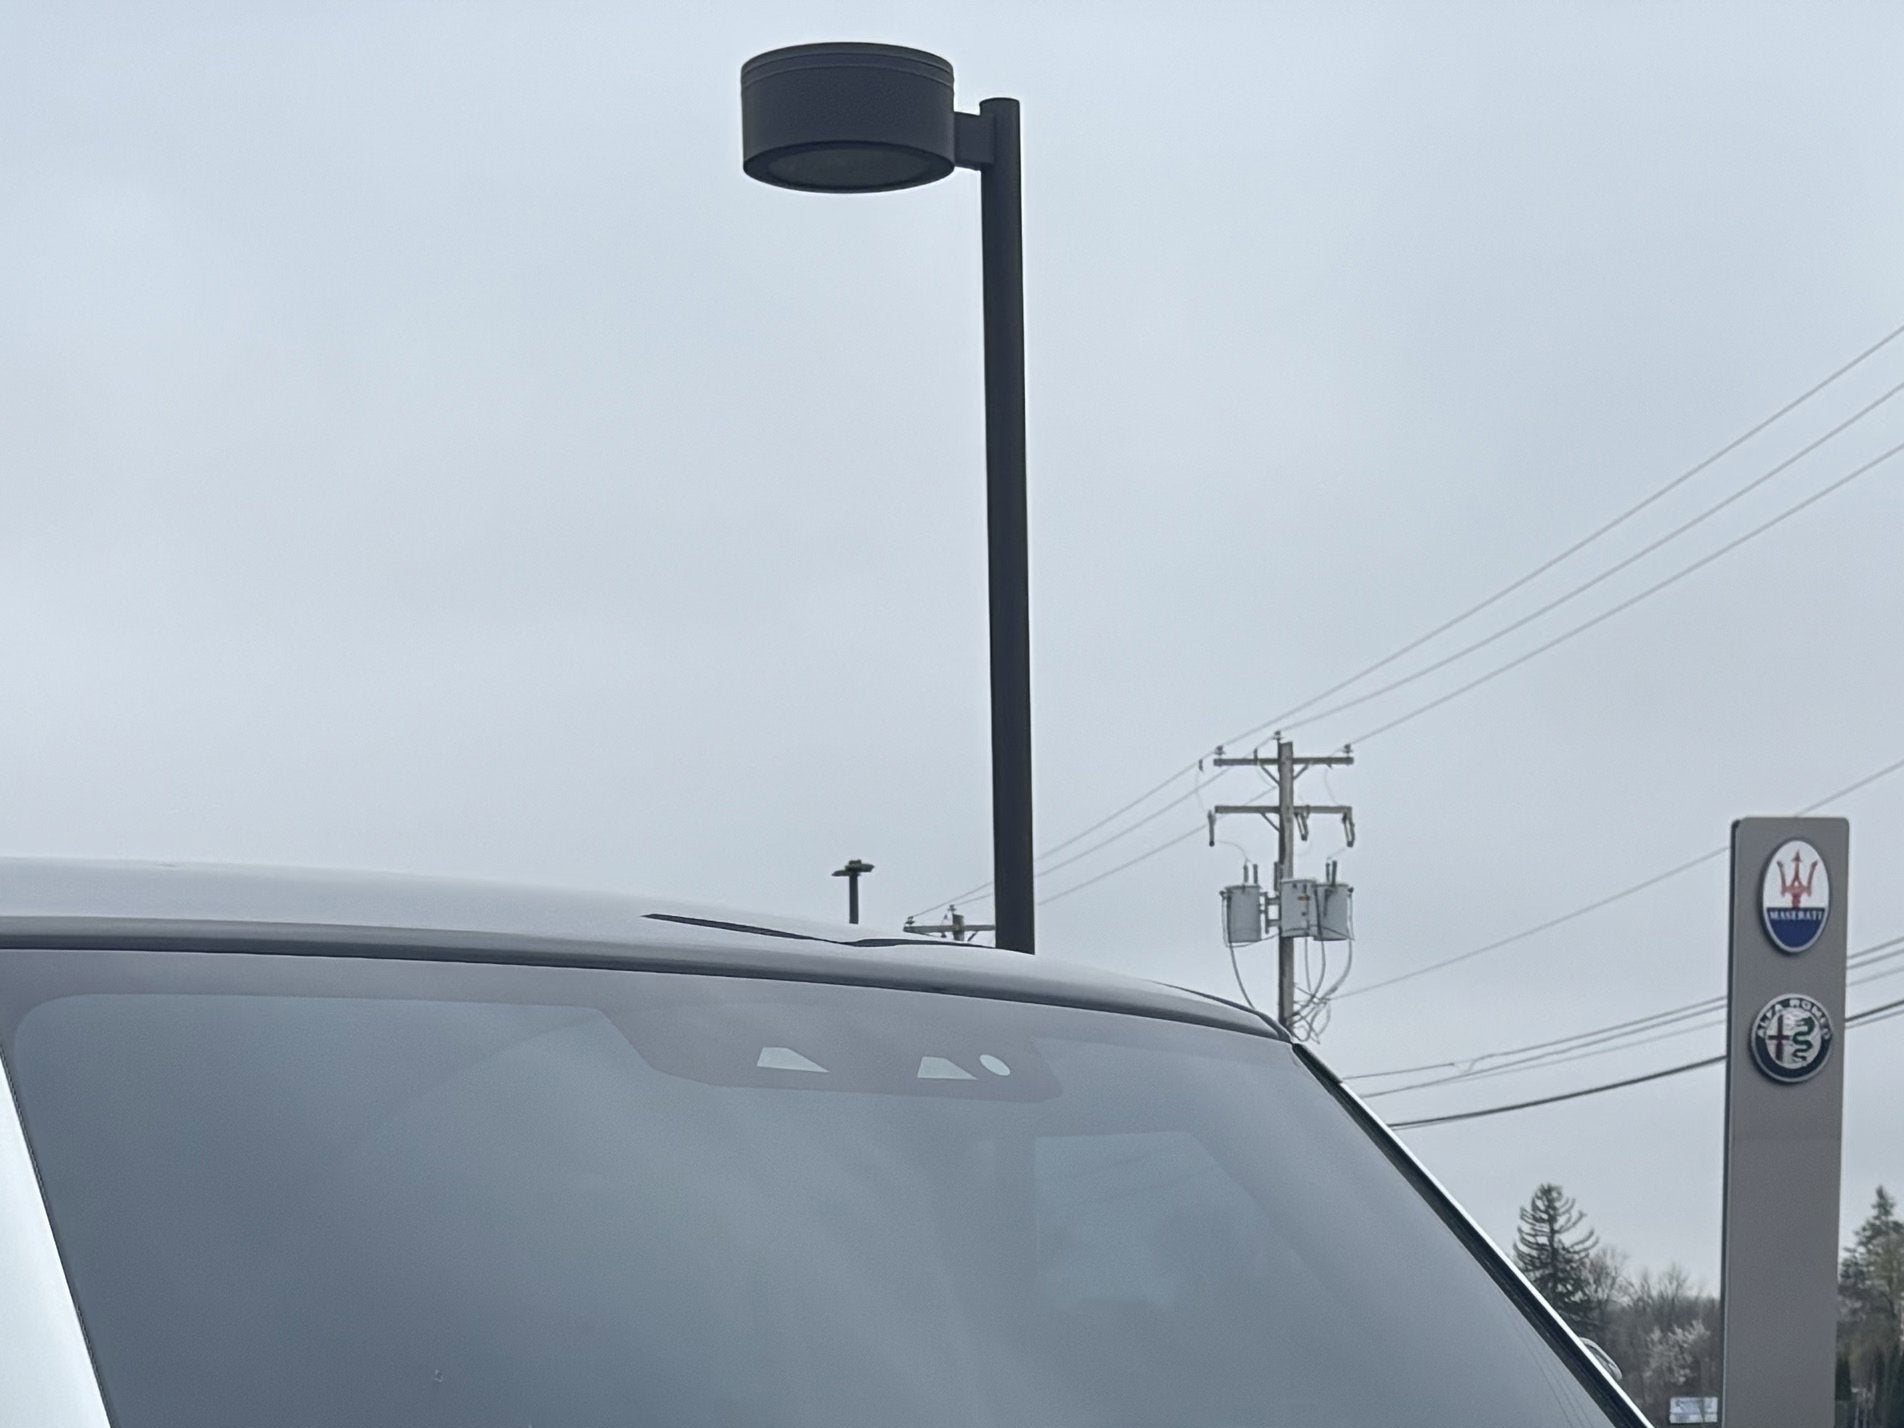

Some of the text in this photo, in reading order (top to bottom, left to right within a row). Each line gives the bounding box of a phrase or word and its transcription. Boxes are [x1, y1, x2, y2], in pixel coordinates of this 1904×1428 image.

[1769, 910, 1824, 922] MASERATI
[1756, 1000, 1832, 1041] ALFA ROMEO
